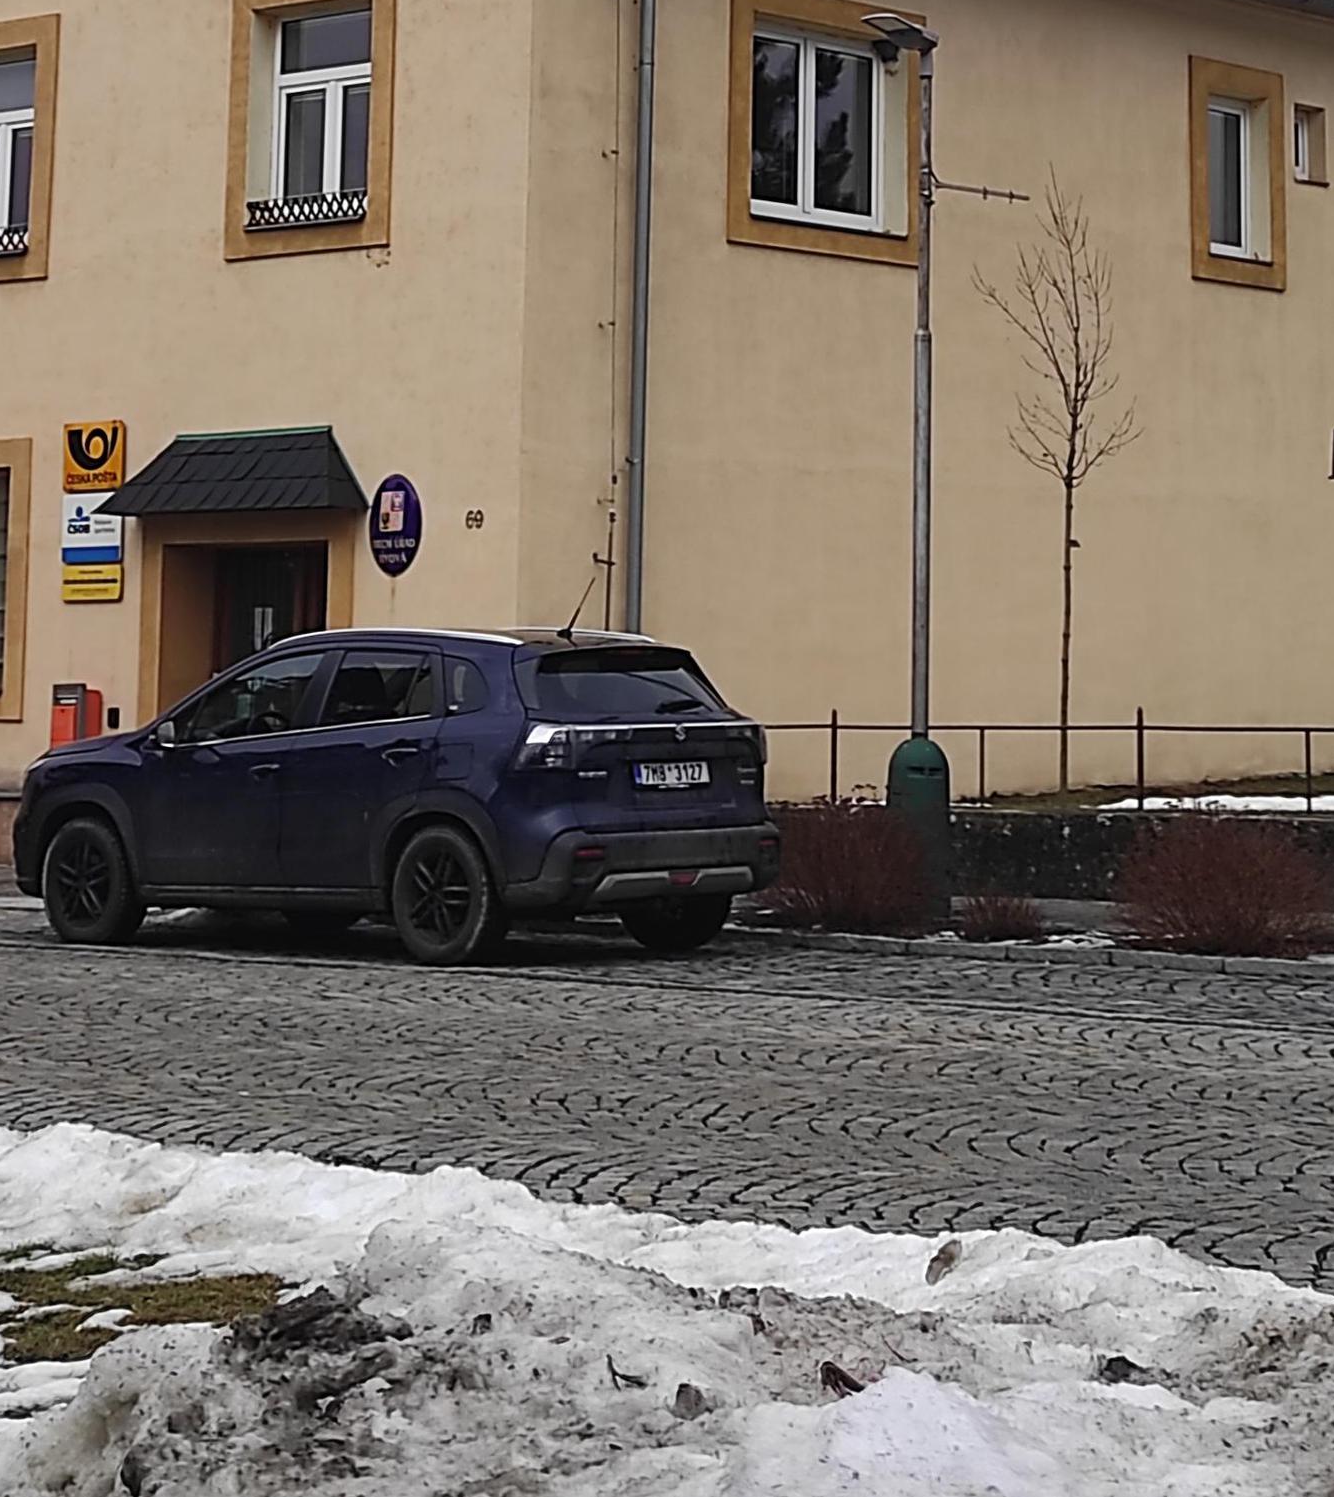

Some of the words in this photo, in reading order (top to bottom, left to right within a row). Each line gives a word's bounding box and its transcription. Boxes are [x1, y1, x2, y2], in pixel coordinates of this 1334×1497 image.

[92, 470, 118, 483] POŠTA
[465, 509, 485, 529] 69
[673, 762, 703, 782] 3127
